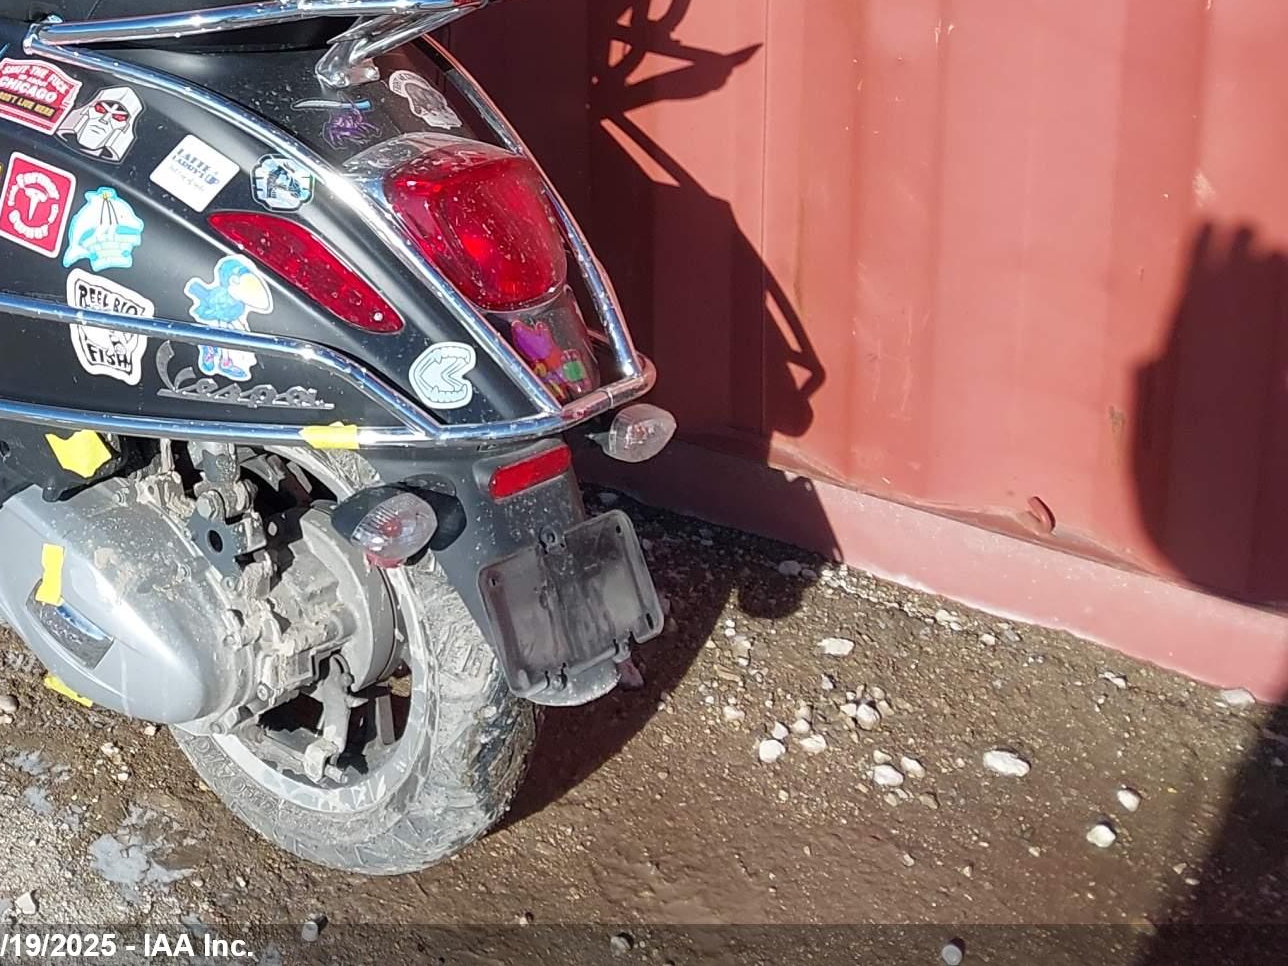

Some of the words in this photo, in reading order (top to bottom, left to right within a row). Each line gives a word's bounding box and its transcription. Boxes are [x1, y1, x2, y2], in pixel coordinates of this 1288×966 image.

[30, 65, 49, 78] THE
[78, 284, 110, 308] REEL
[87, 343, 129, 370] FISH
[156, 340, 336, 411] Vespa
